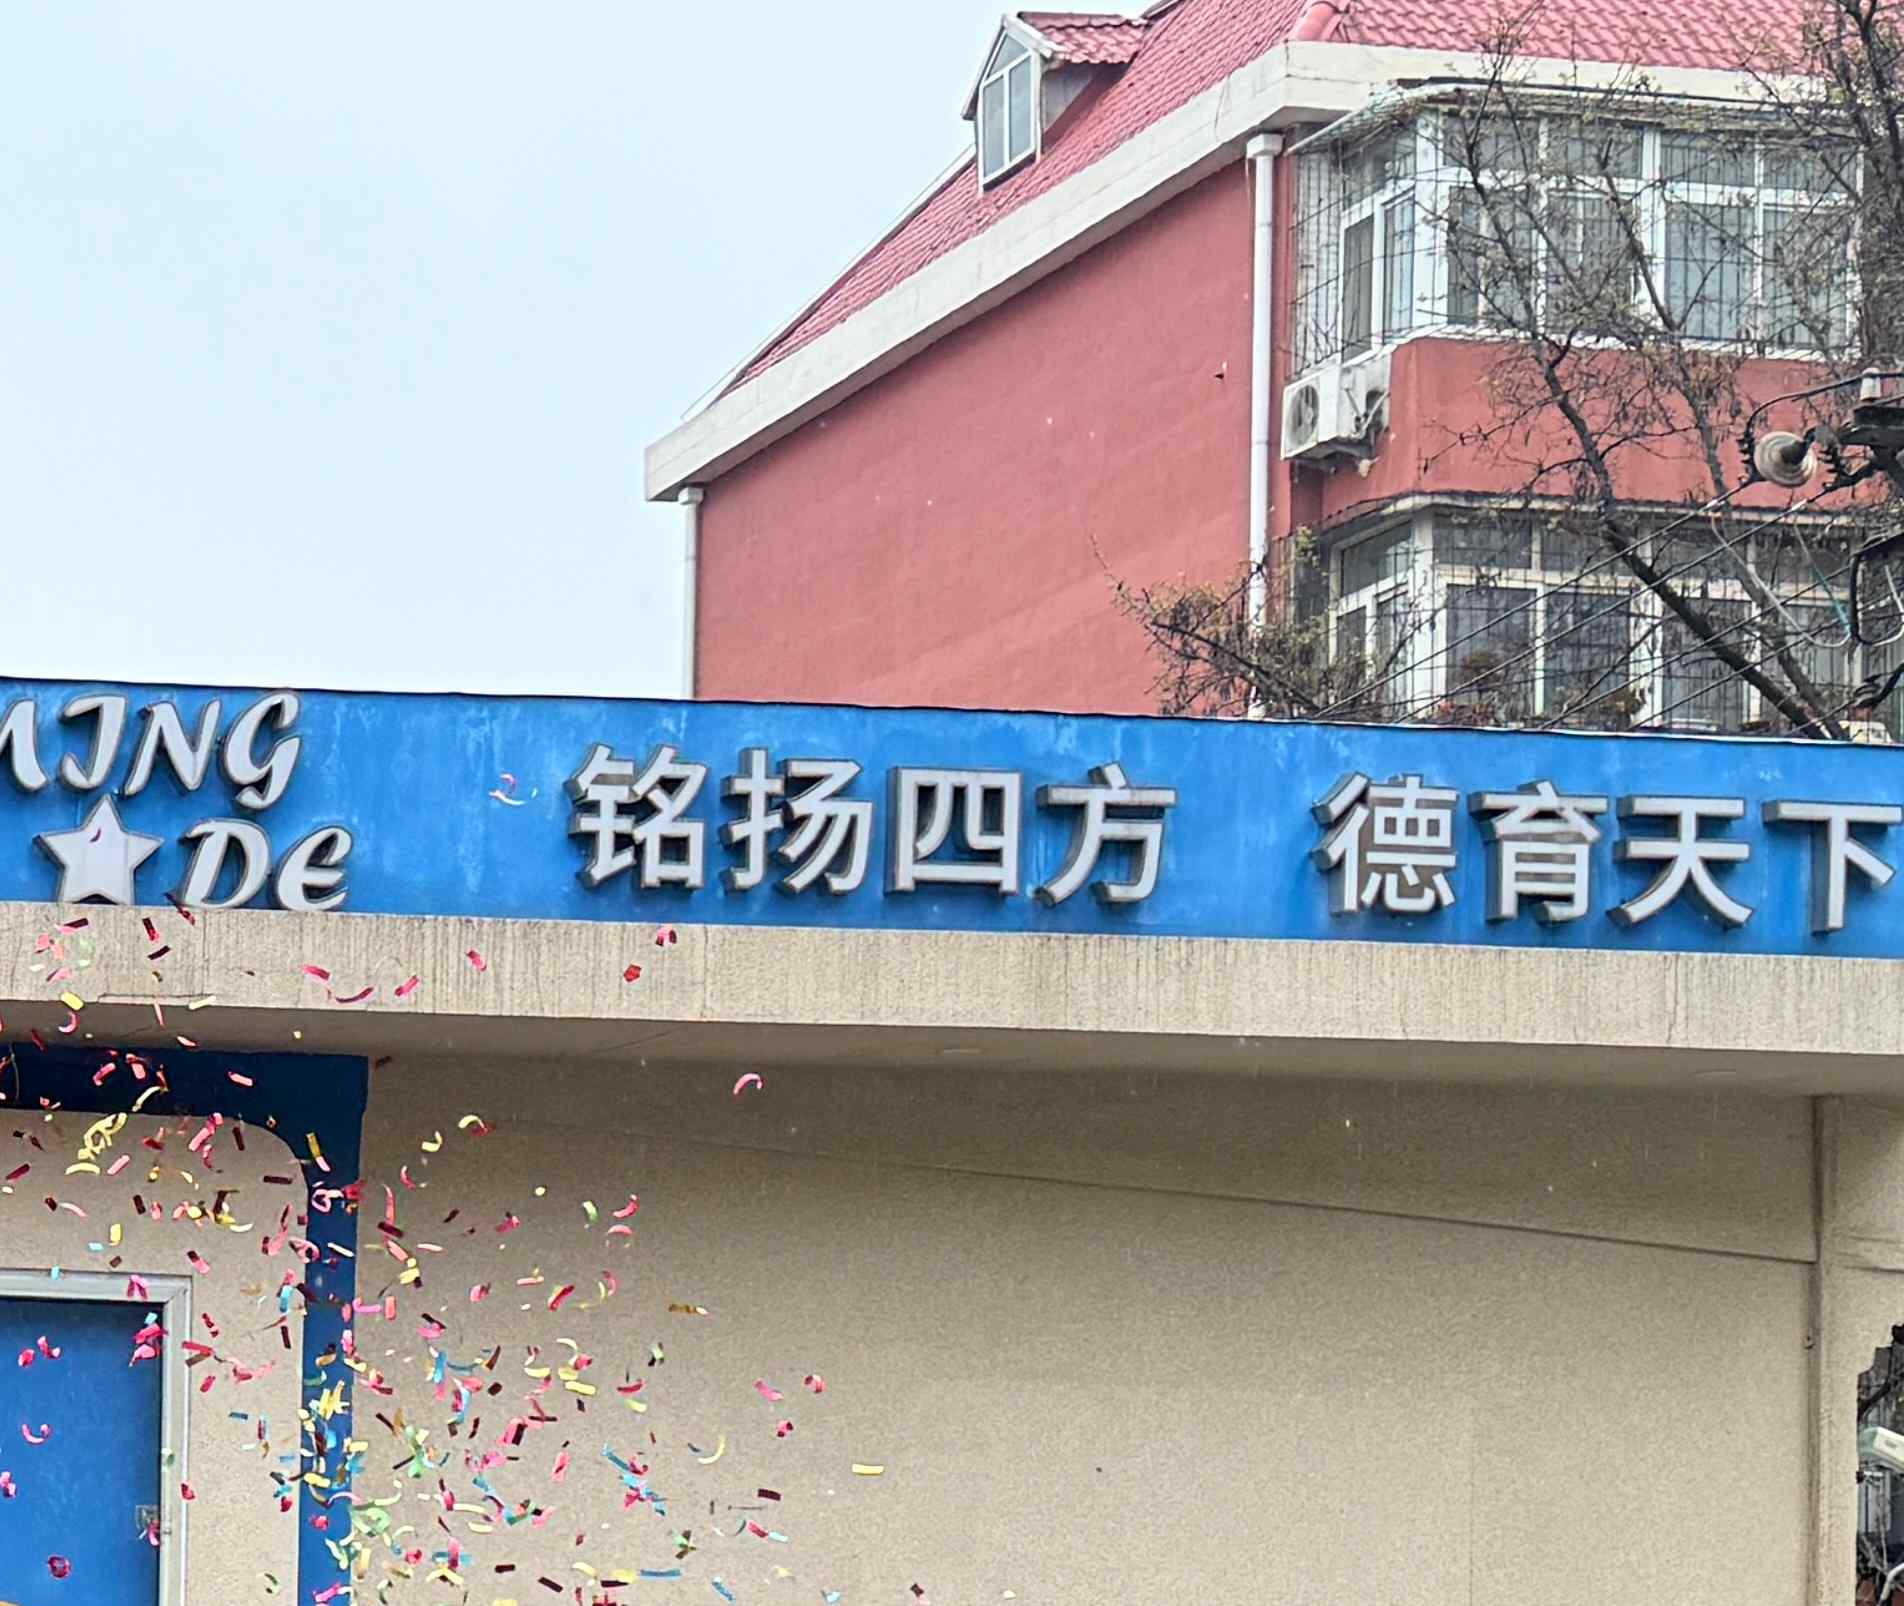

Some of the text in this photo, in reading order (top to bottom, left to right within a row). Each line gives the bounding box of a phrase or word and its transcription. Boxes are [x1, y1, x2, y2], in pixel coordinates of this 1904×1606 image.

[181, 818, 352, 911] DE
[564, 744, 1177, 904] 铭扬四方
[1310, 772, 1904, 934] 德育天下
